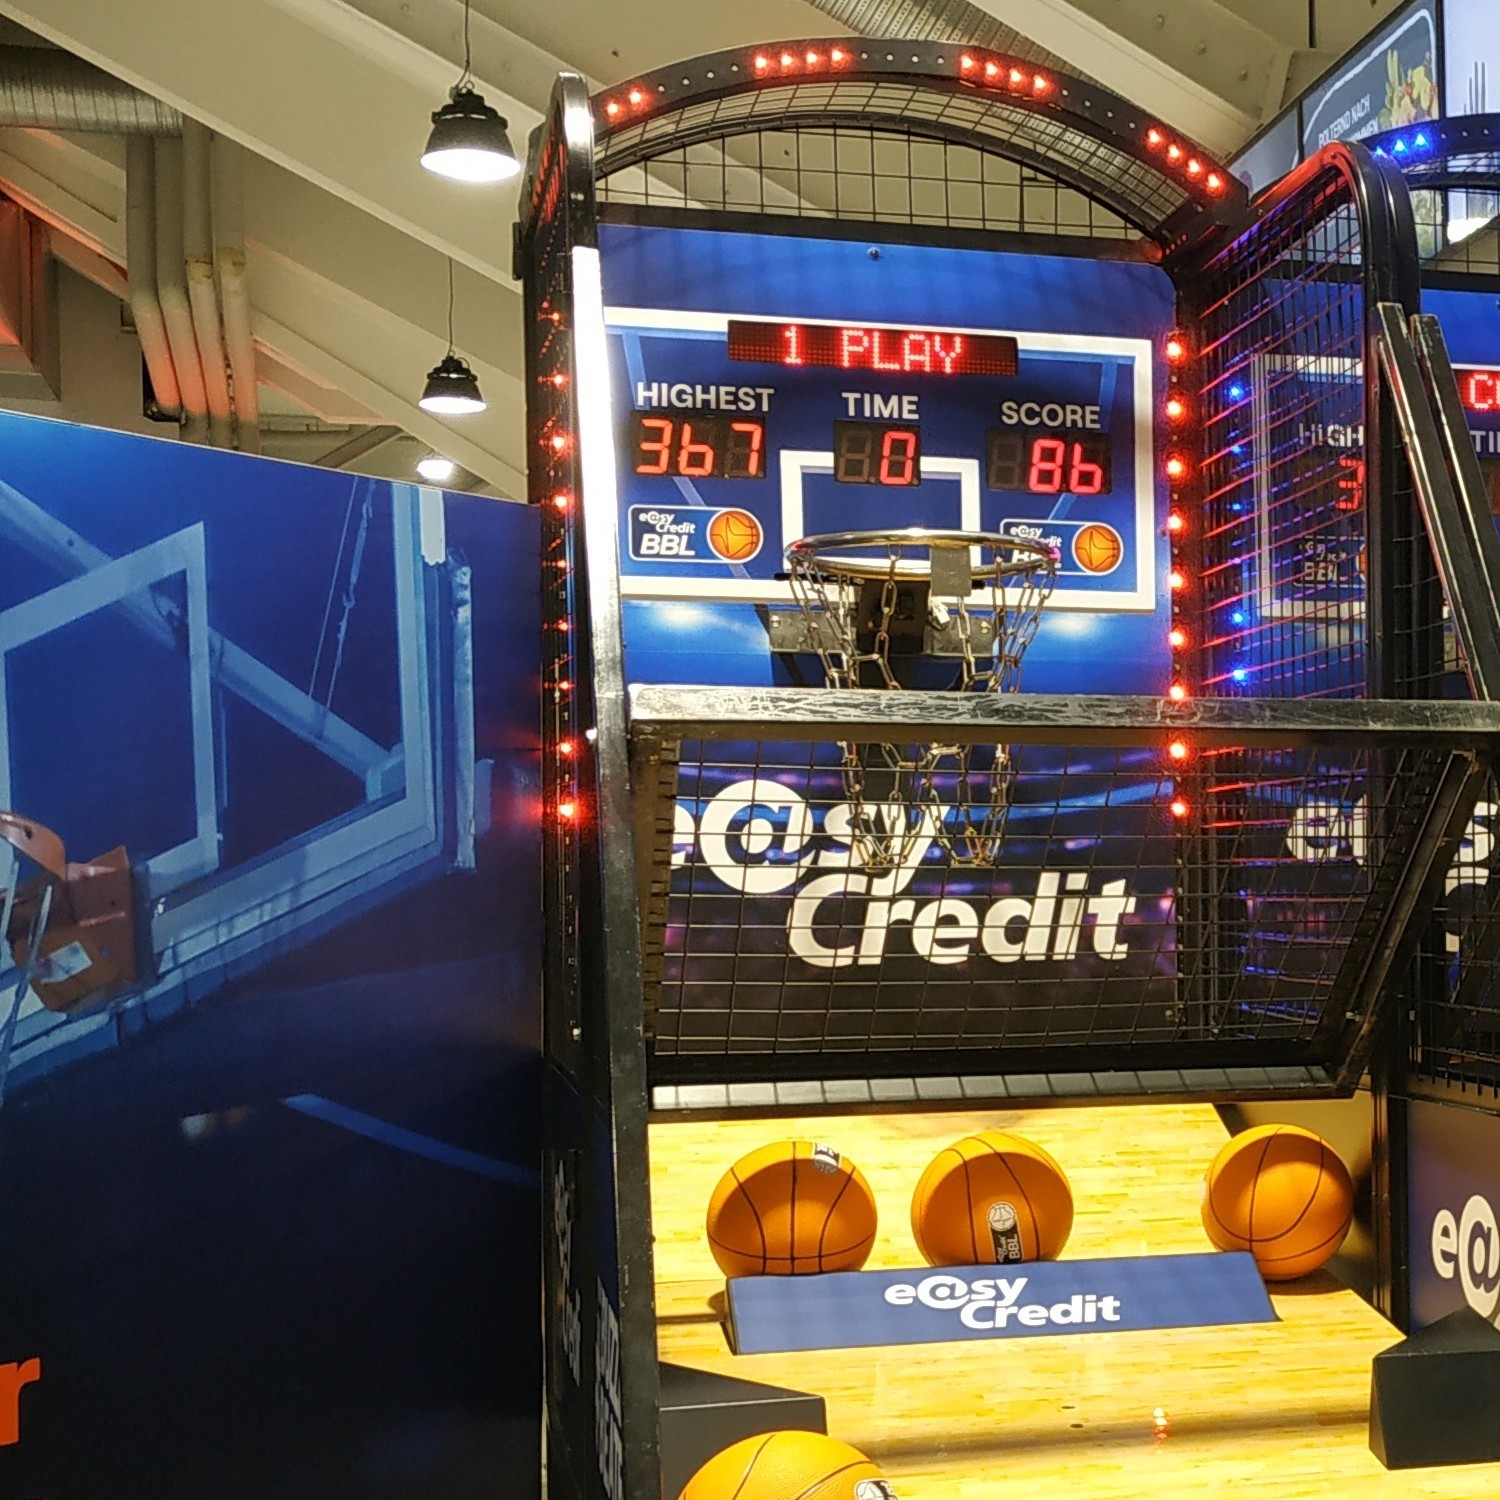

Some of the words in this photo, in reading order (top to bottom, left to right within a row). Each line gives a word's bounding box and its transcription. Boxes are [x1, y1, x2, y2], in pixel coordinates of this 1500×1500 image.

[784, 325, 803, 365] 1
[842, 329, 962, 374] PLAY
[637, 381, 775, 413] HIGHEST
[842, 391, 920, 421] TIME
[1001, 401, 1101, 430] SCORE
[637, 417, 765, 476] 367
[1298, 422, 1365, 448] HIGH
[1029, 437, 1103, 495] 86
[655, 522, 697, 534] Credit
[640, 533, 696, 556] BBL
[787, 871, 1137, 968] Credit
[960, 1294, 1121, 1329] Credit
